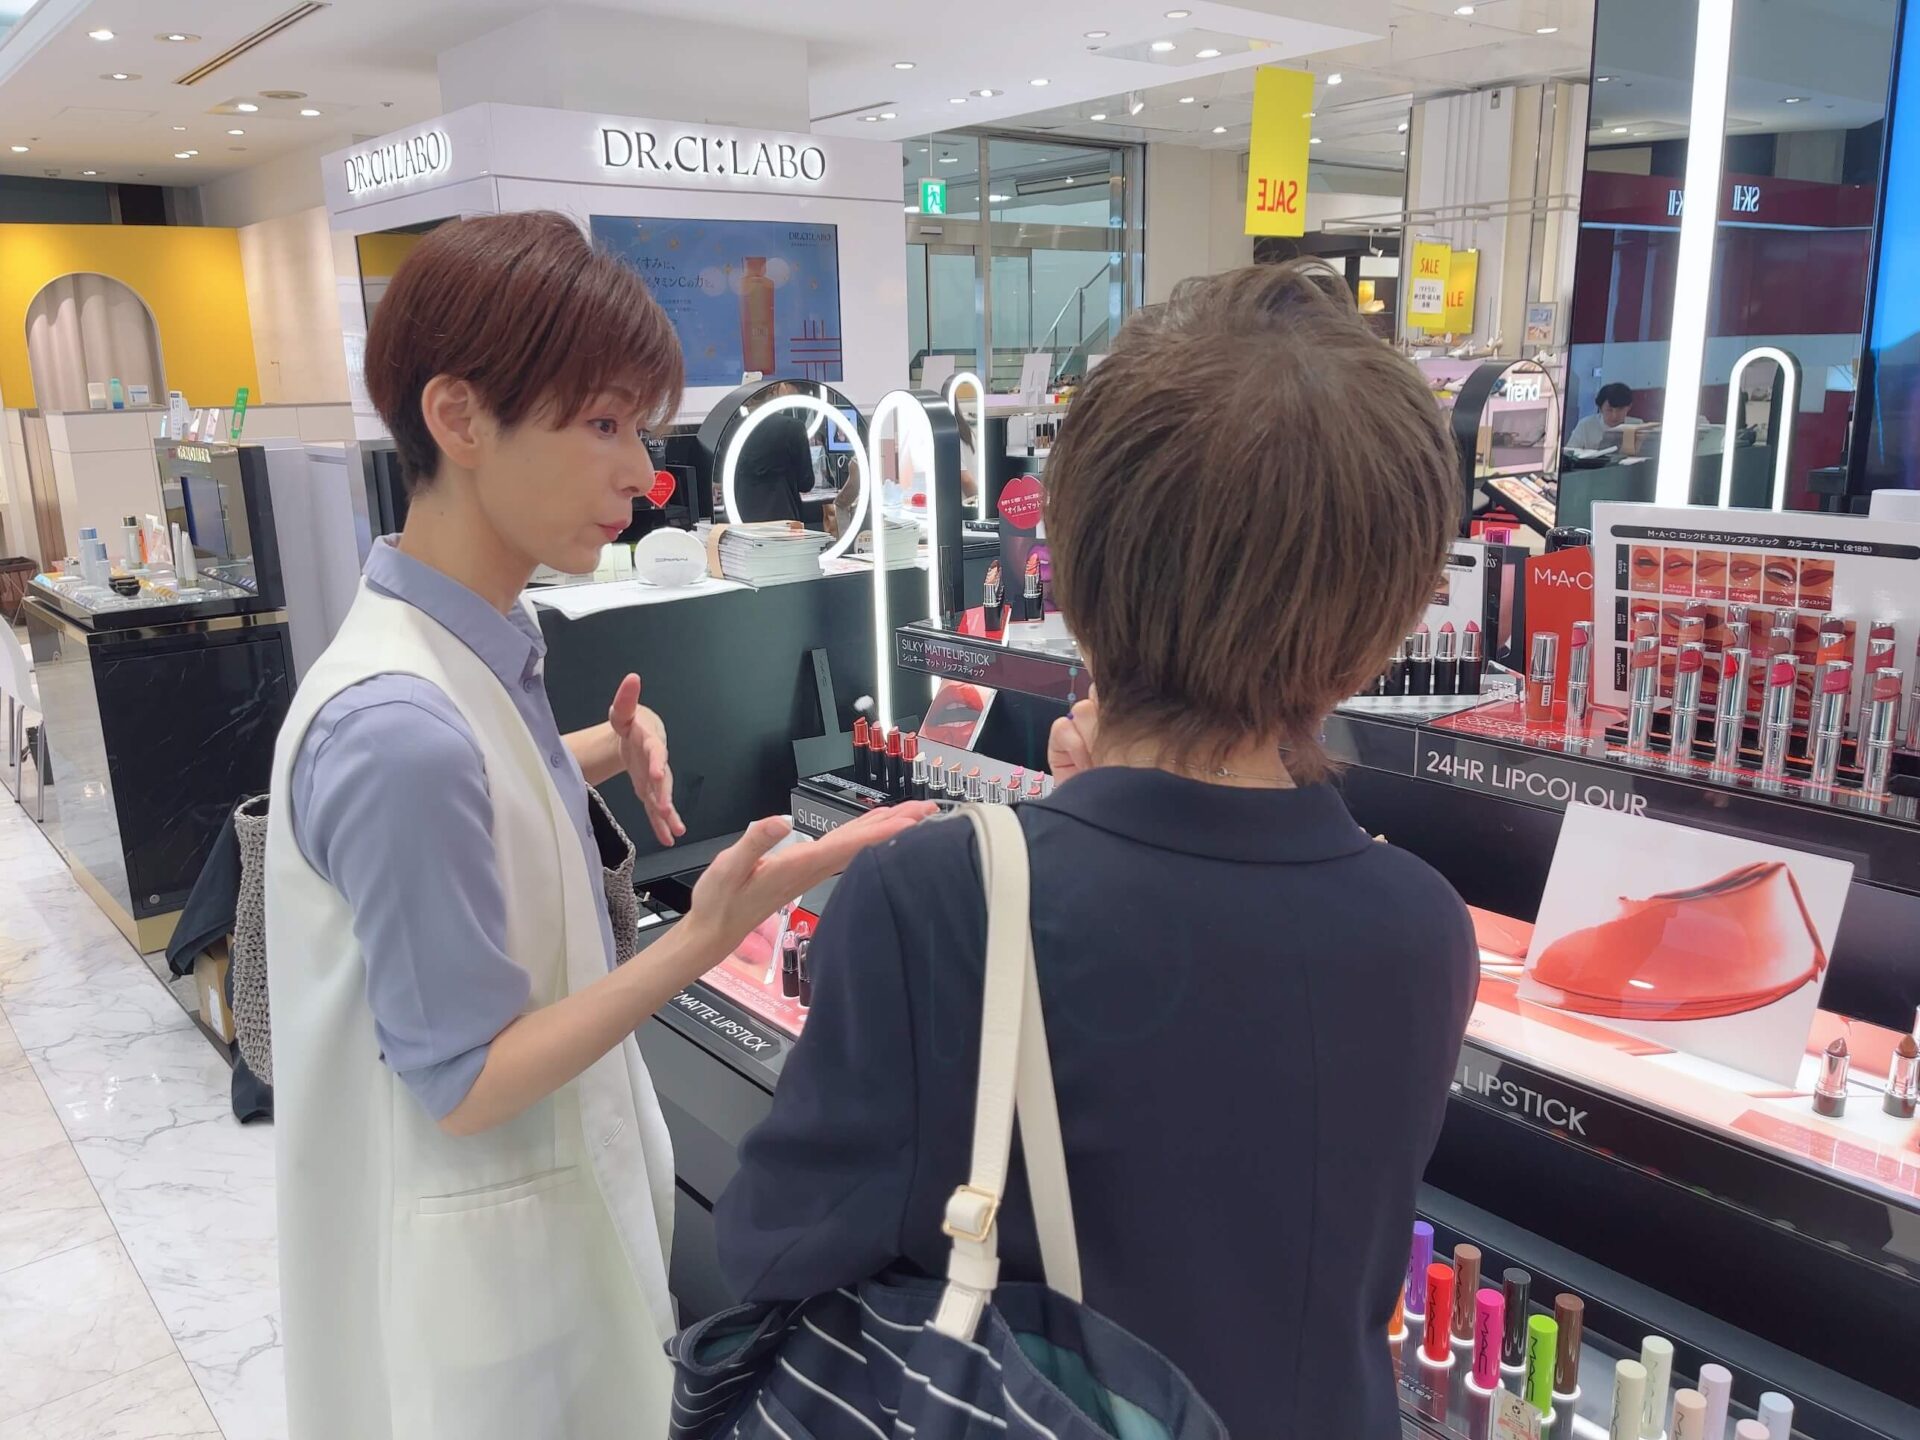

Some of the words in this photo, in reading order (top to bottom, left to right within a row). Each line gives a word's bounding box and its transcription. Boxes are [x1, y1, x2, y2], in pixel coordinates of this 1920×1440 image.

[602, 128, 826, 180] DR.CI:LABO
[1420, 257, 1440, 274] SALE
[648, 439, 665, 447] NEW
[1708, 533, 1722, 541] キス
[902, 638, 924, 653] SILKY
[924, 643, 952, 659] MATTE
[952, 648, 990, 666] LIPSTICK
[925, 658, 940, 667] マット
[1426, 751, 1484, 783] 24HR
[1491, 764, 1649, 818] LIPCOLOUR
[798, 808, 829, 833] SLEEK
[674, 990, 720, 1020] MATTE
[710, 1015, 772, 1052] LIPSTICK
[1463, 1065, 1588, 1136] LIPSTICK
